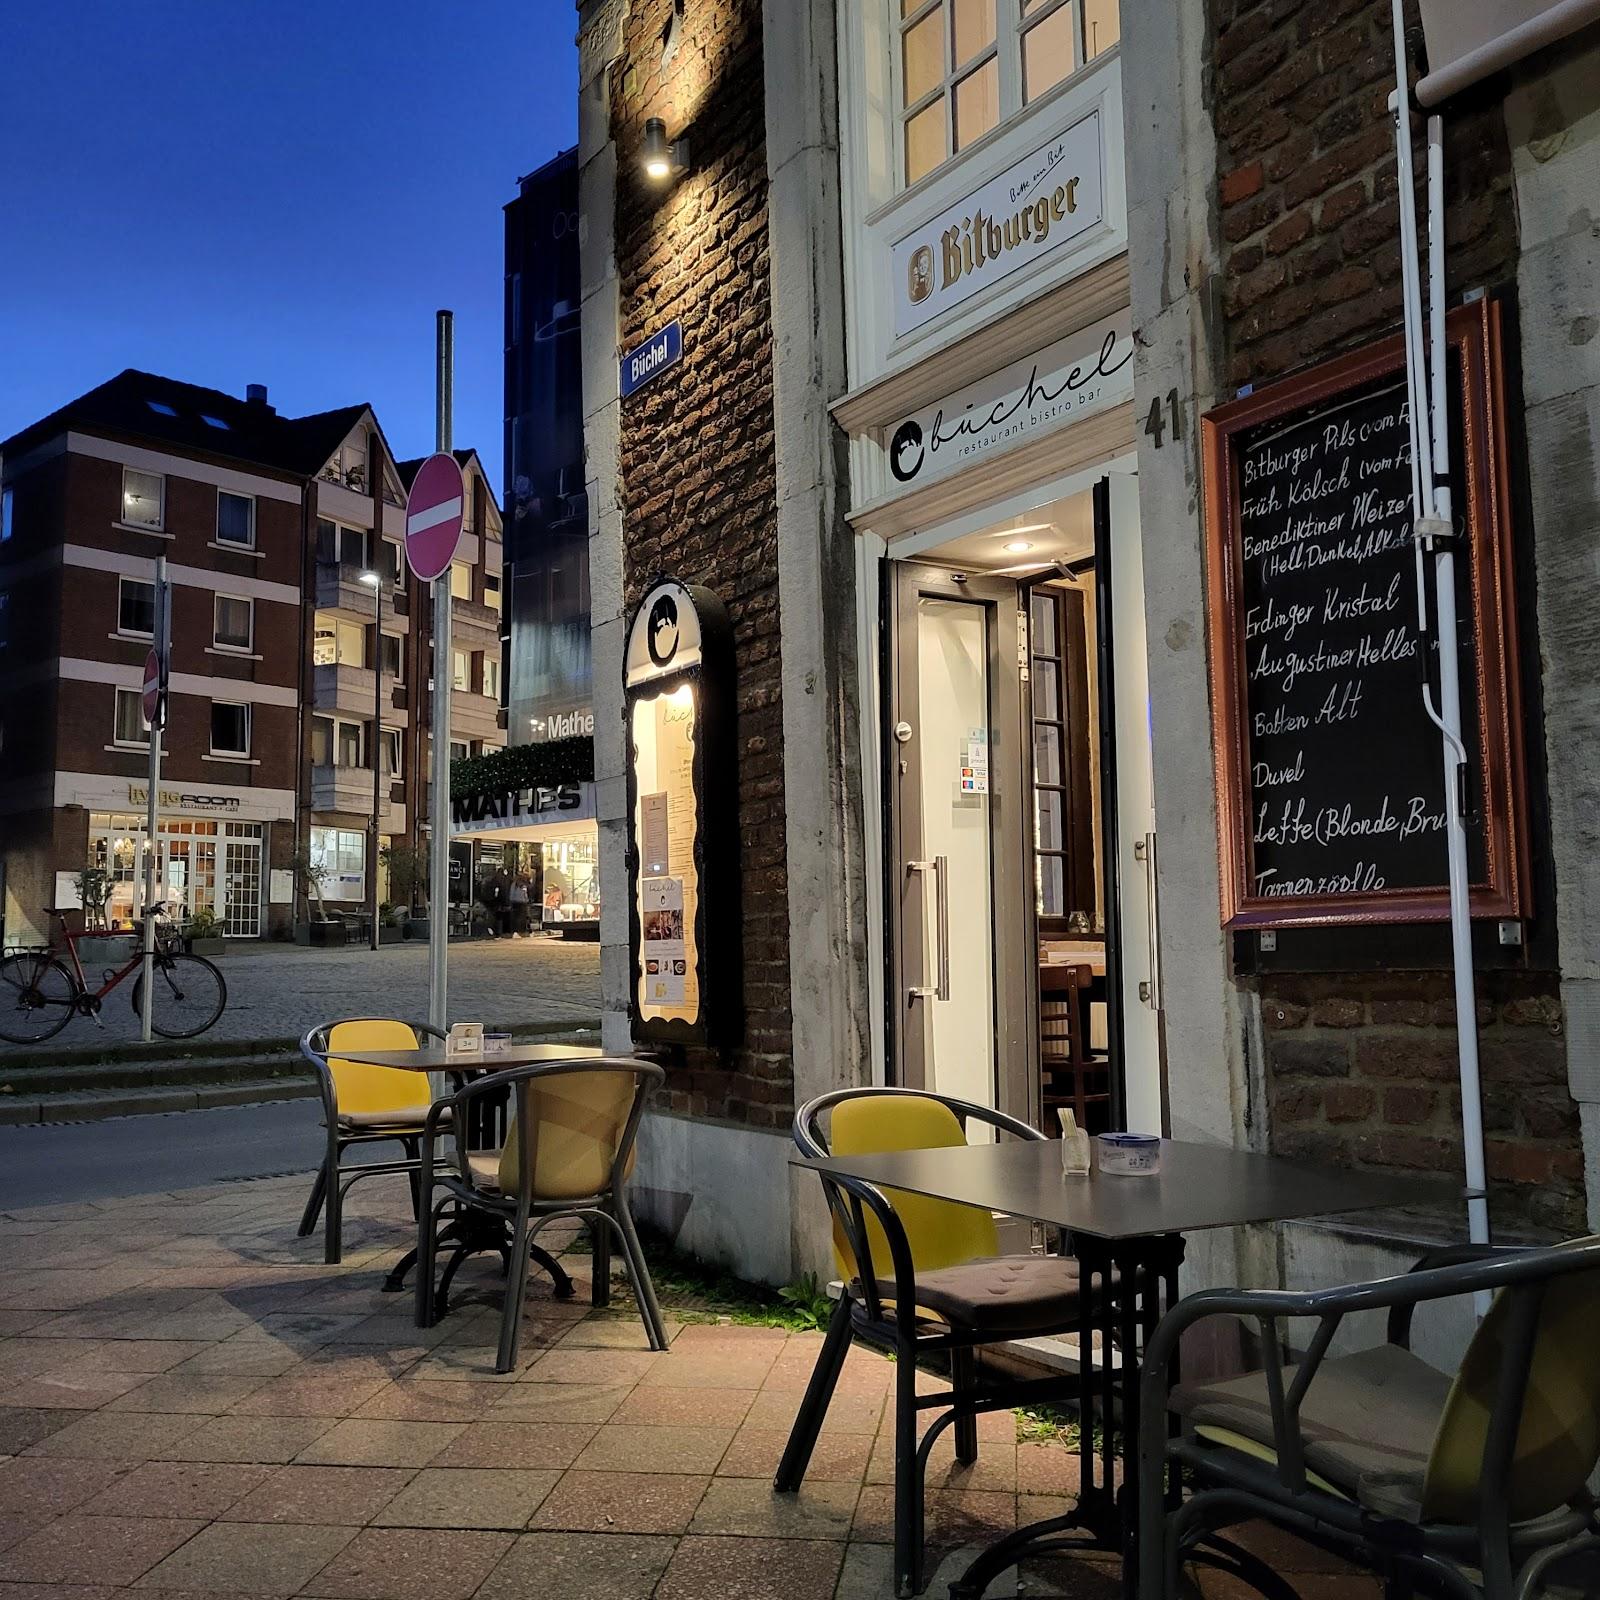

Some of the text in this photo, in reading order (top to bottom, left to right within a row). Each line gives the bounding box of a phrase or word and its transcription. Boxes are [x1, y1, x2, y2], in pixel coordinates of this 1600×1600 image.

[1010, 181, 1030, 203] Bitte
[1047, 144, 1065, 166] Bit
[940, 176, 1080, 292] Bitburger
[631, 335, 668, 383] Büchel
[931, 330, 1134, 452] büchel
[958, 387, 1102, 457] restaurant bistro bar
[1144, 387, 1181, 449] 41
[1244, 401, 1411, 488] Bitburger Pils (vom Fa
[1241, 442, 1413, 520] Früh Kölsch (vom Fa
[1243, 512, 1345, 561] Benediktiner
[1245, 572, 1400, 641] Erdinger Kristal
[1250, 625, 1417, 692] Augustiner Helles
[548, 711, 594, 738] Mathe
[1314, 679, 1362, 724] Alt
[1252, 750, 1305, 788] Duvel
[453, 780, 580, 823] MATHES
